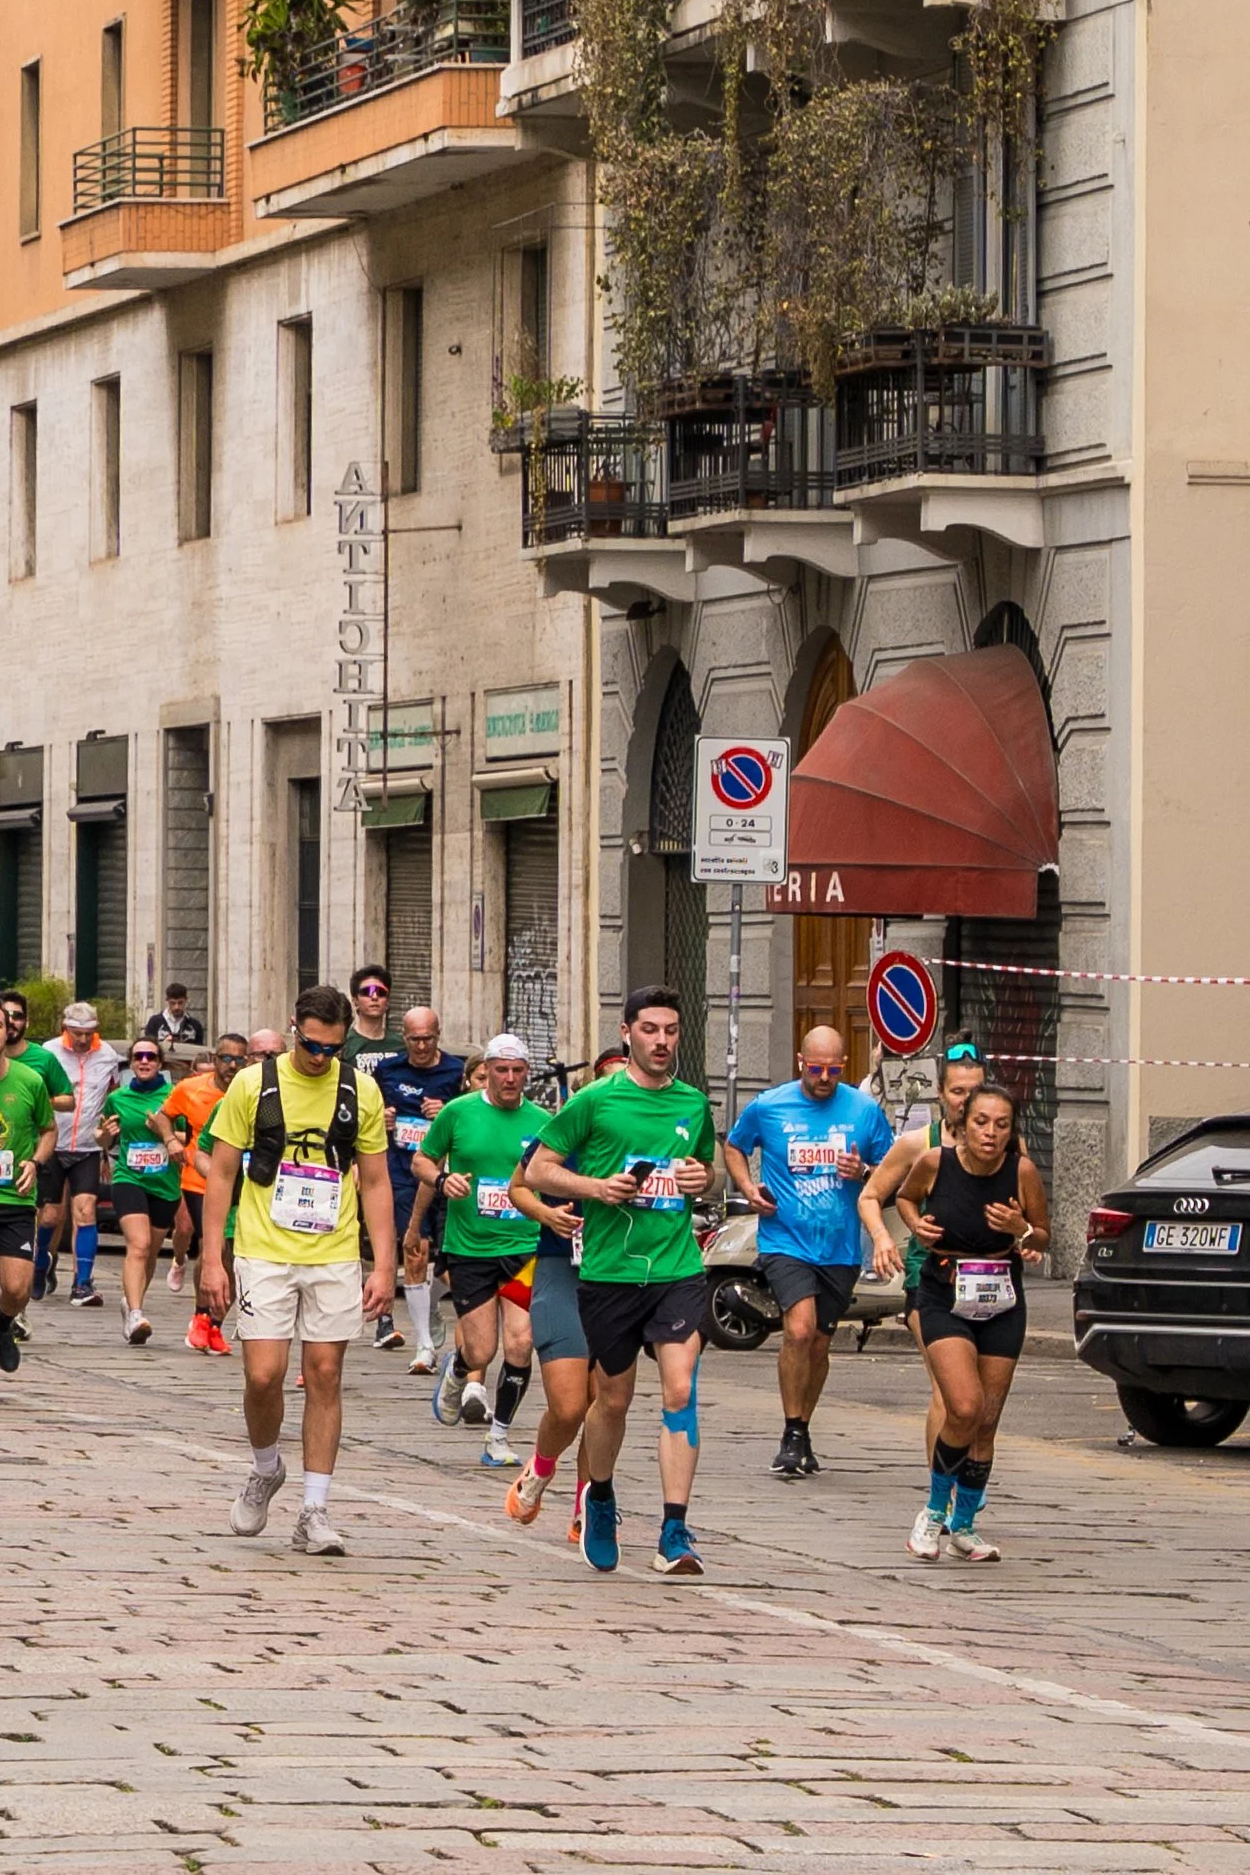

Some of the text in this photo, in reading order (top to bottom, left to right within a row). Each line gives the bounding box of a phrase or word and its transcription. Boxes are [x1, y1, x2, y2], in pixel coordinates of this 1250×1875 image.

[767, 871, 845, 903] ERIA
[798, 1148, 835, 1164] 33410
[488, 1192, 514, 1209] 126
[1156, 1227, 1176, 1247] GE
